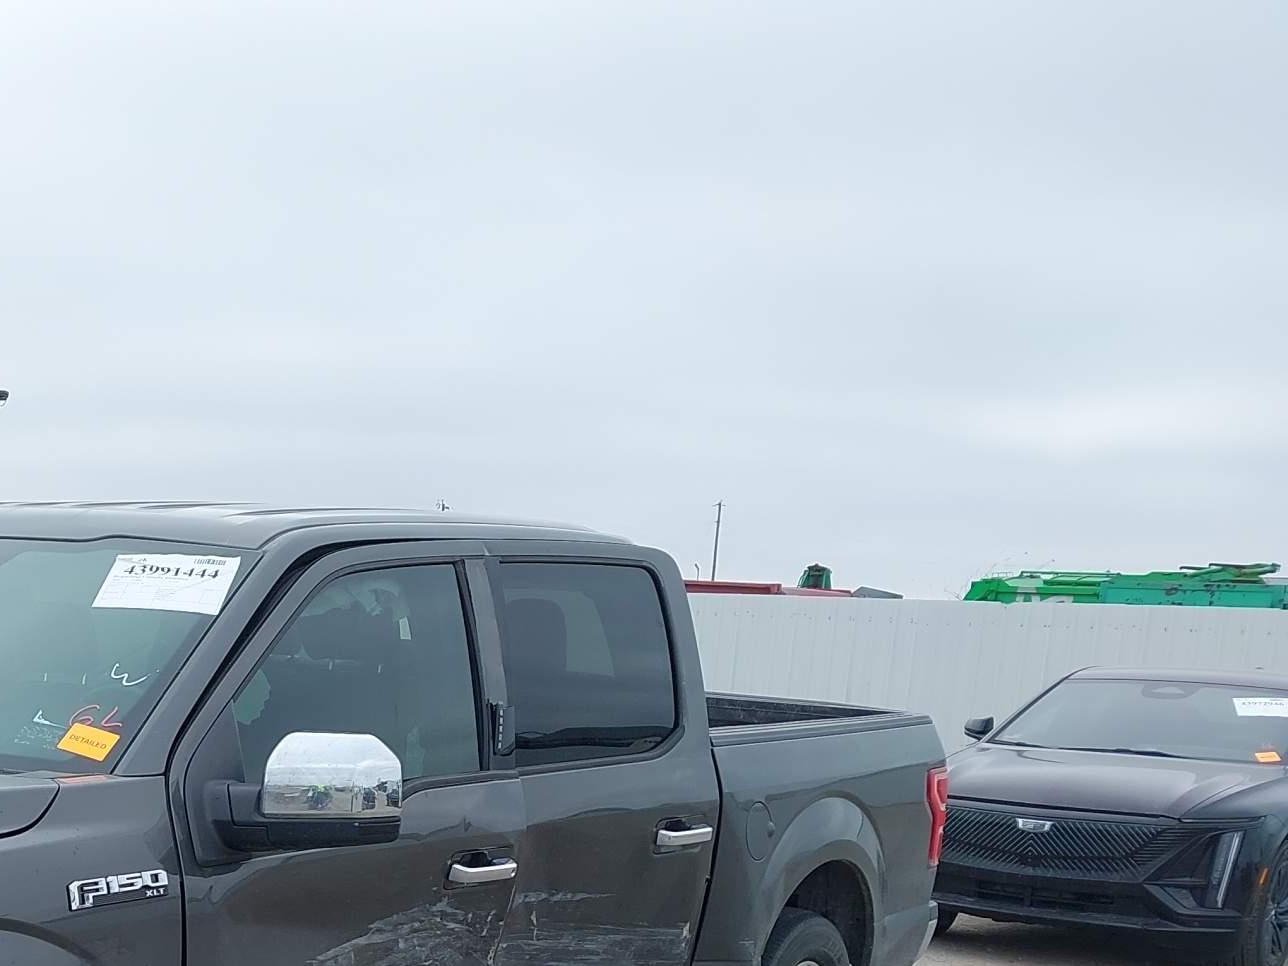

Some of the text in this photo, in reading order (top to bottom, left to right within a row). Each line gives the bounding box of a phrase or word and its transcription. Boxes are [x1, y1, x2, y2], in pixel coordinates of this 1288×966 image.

[123, 563, 221, 580] 43991444
[68, 733, 108, 751] DETAILED
[145, 887, 166, 897] XLT
